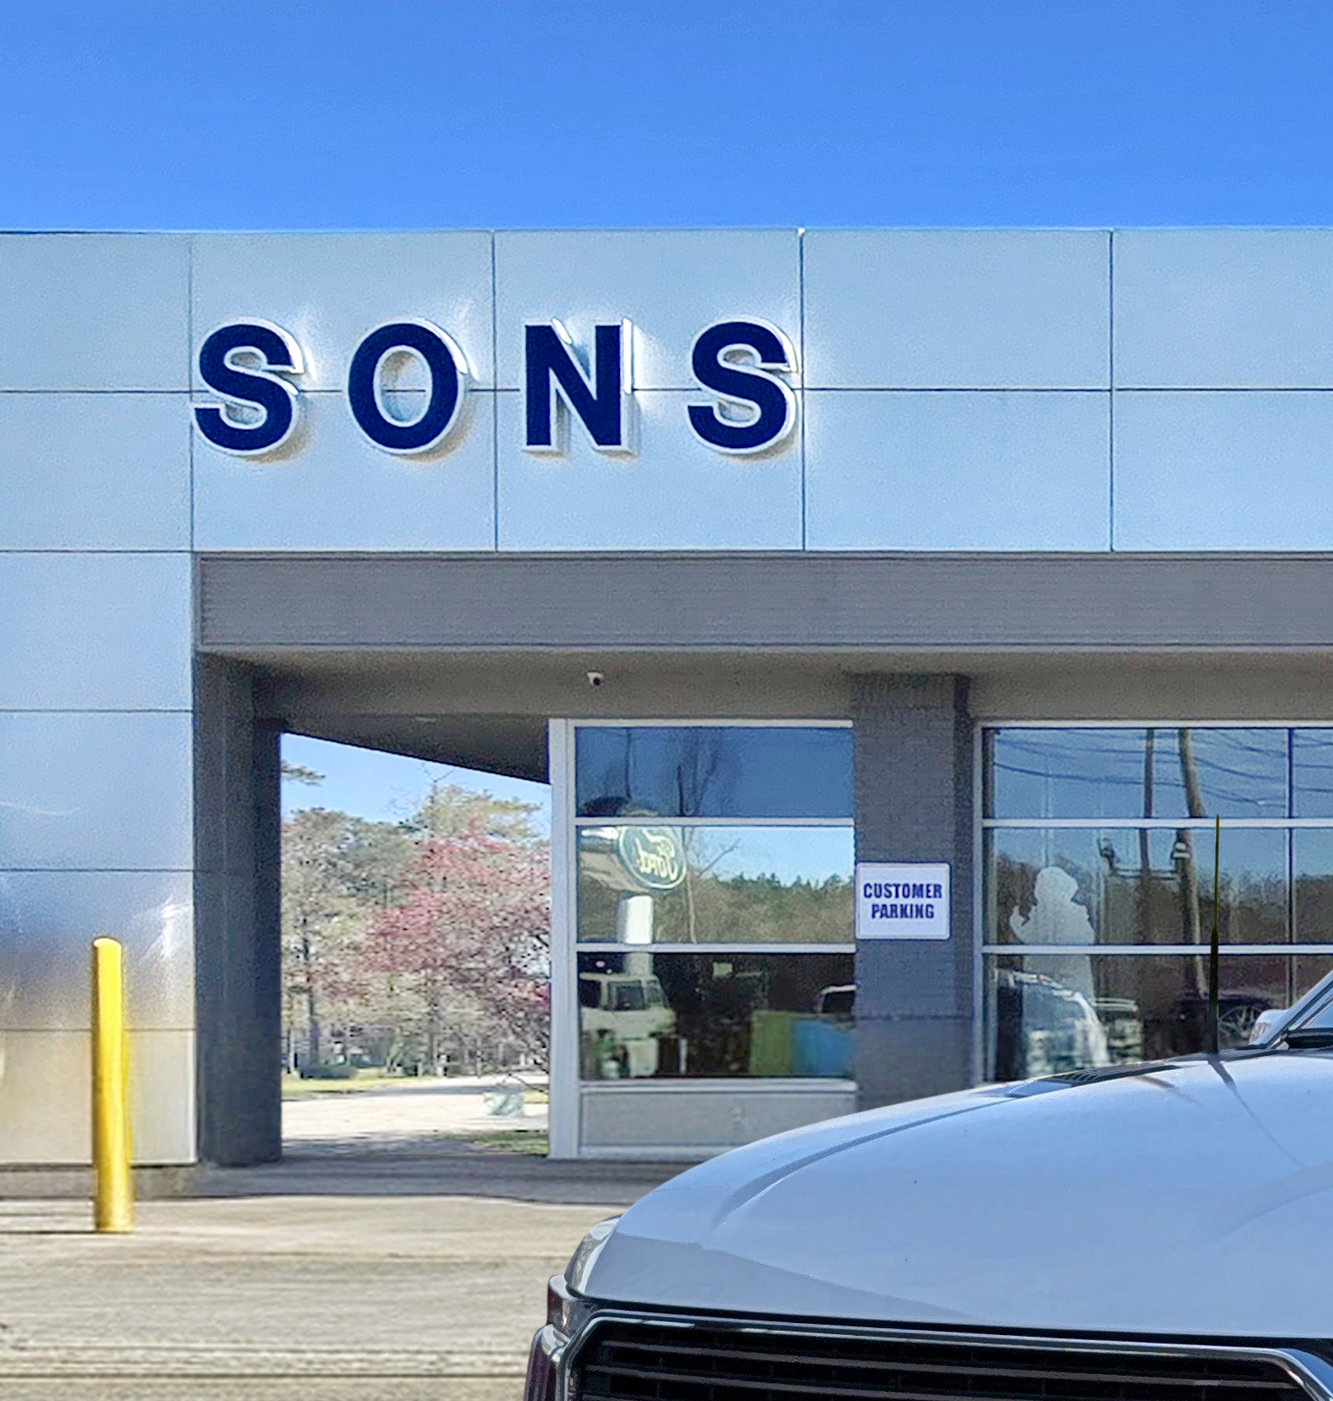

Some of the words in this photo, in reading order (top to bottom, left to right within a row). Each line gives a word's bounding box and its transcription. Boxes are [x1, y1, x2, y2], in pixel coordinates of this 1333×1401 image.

[192, 320, 804, 454] SONS
[863, 883, 943, 899] CUSTOMER
[871, 903, 935, 919] PARKING
